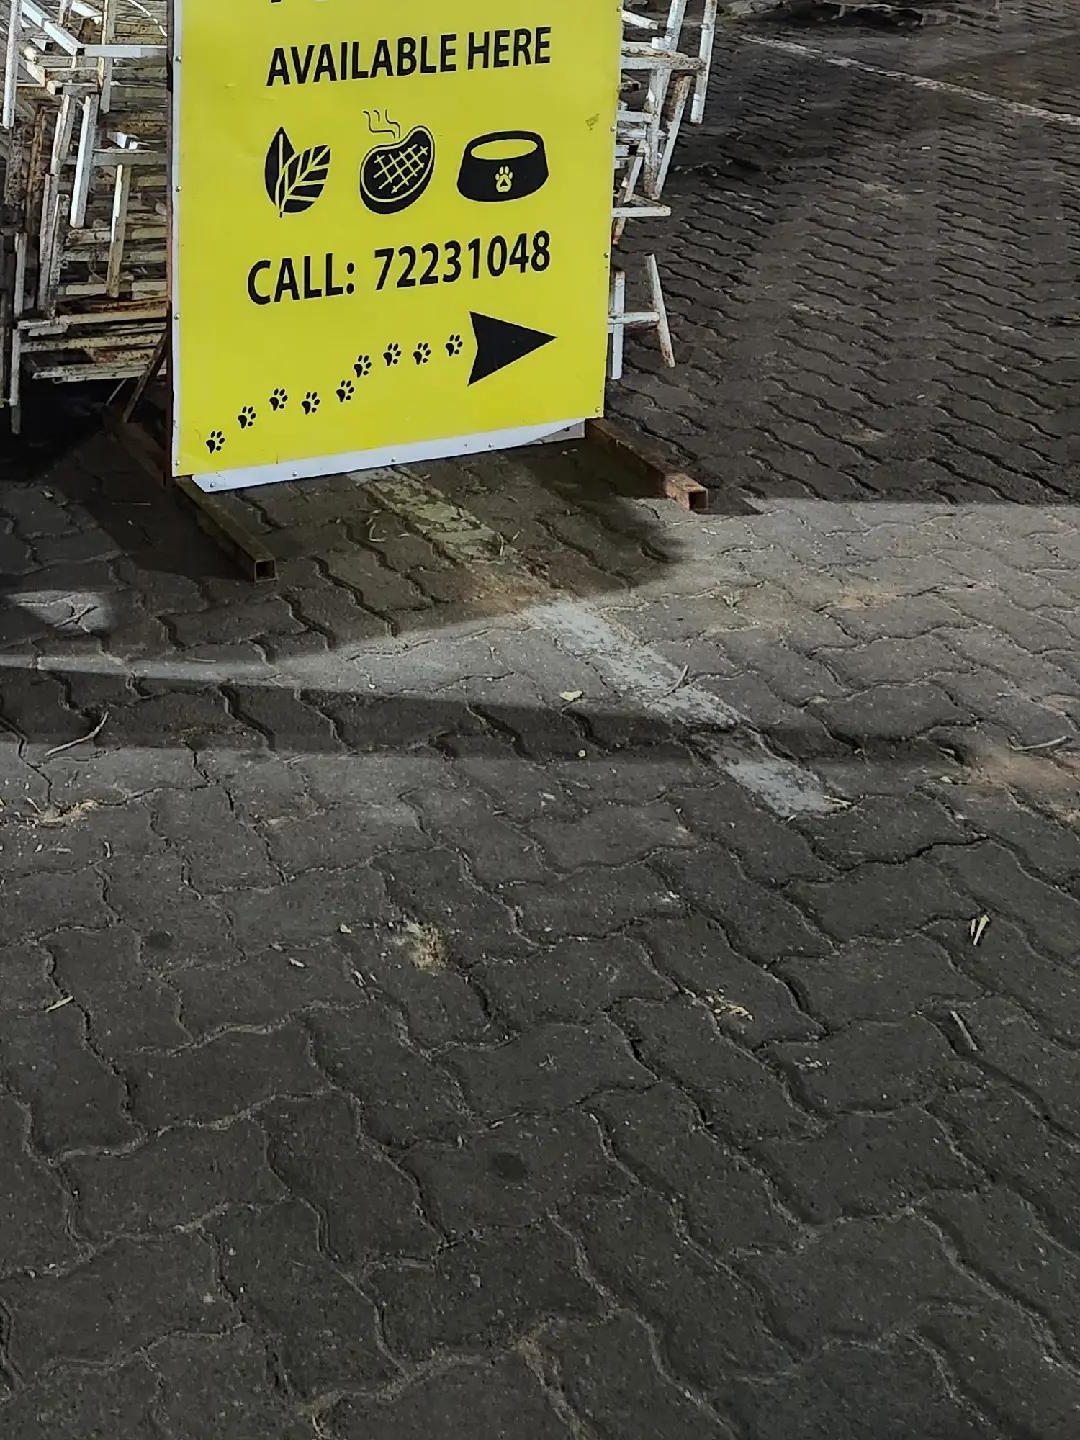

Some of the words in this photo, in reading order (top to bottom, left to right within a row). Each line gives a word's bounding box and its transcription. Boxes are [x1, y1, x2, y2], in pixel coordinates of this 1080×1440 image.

[265, 33, 458, 87] AVAILABLE
[467, 26, 552, 71] HERE
[247, 252, 357, 306] CALL:
[374, 230, 552, 292] 72231048
